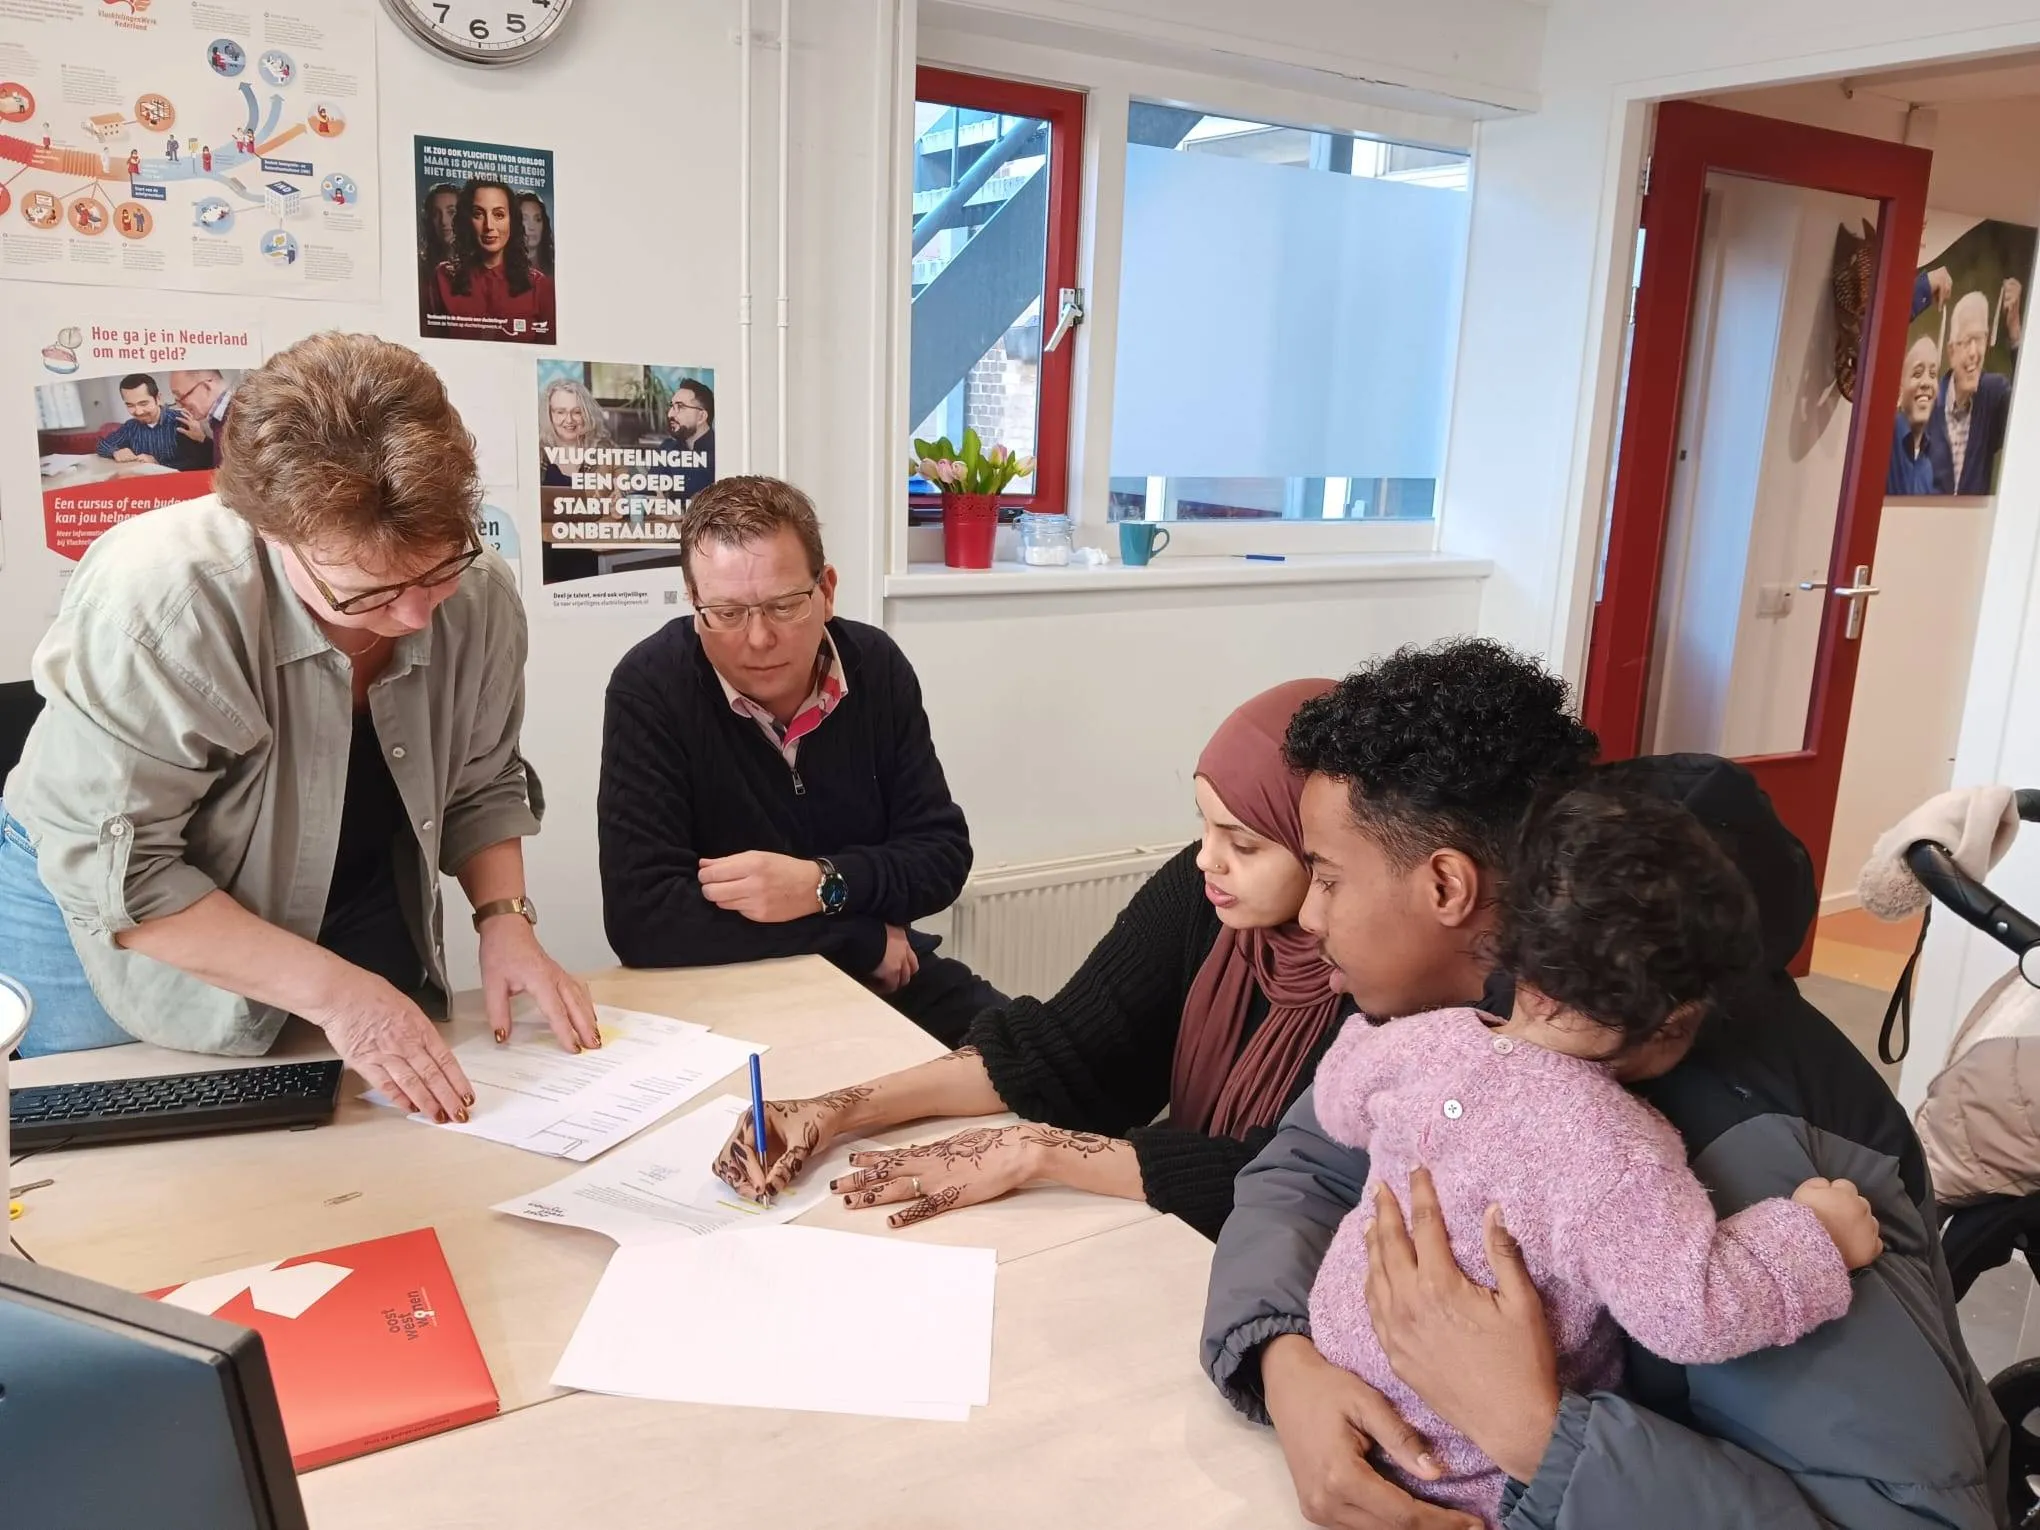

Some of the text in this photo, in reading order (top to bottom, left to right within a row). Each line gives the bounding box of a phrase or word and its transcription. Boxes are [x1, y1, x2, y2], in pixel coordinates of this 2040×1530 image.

[433, 3, 450, 23] 7
[506, 13, 526, 33] 5
[115, 20, 148, 31] Nederland
[469, 19, 489, 40] 6
[424, 146, 432, 154] IK
[433, 147, 447, 155] ZOU
[447, 149, 462, 157] OOK
[463, 151, 498, 161] VLUCHTEN
[499, 155, 516, 163] VOOR
[424, 155, 546, 177] MAAR IS OPVANG IN DE REGIO
[424, 166, 546, 188] NIET BETER VOOR IEDEREEN?
[92, 326, 248, 346] Hoe ga je in Nederland
[93, 347, 187, 363] om met geld?
[544, 447, 707, 468] VLUCHTELINGEN
[572, 473, 685, 491] EEN GOEDE
[55, 497, 181, 512] Een cursus of een bud
[553, 497, 612, 515] START
[615, 498, 682, 515] GEVEN
[55, 512, 76, 523] kan
[78, 512, 97, 525] jou
[551, 521, 682, 539] ONBETAALBA
[381, 1308, 400, 1333] oost
[398, 1312, 418, 1341] west
